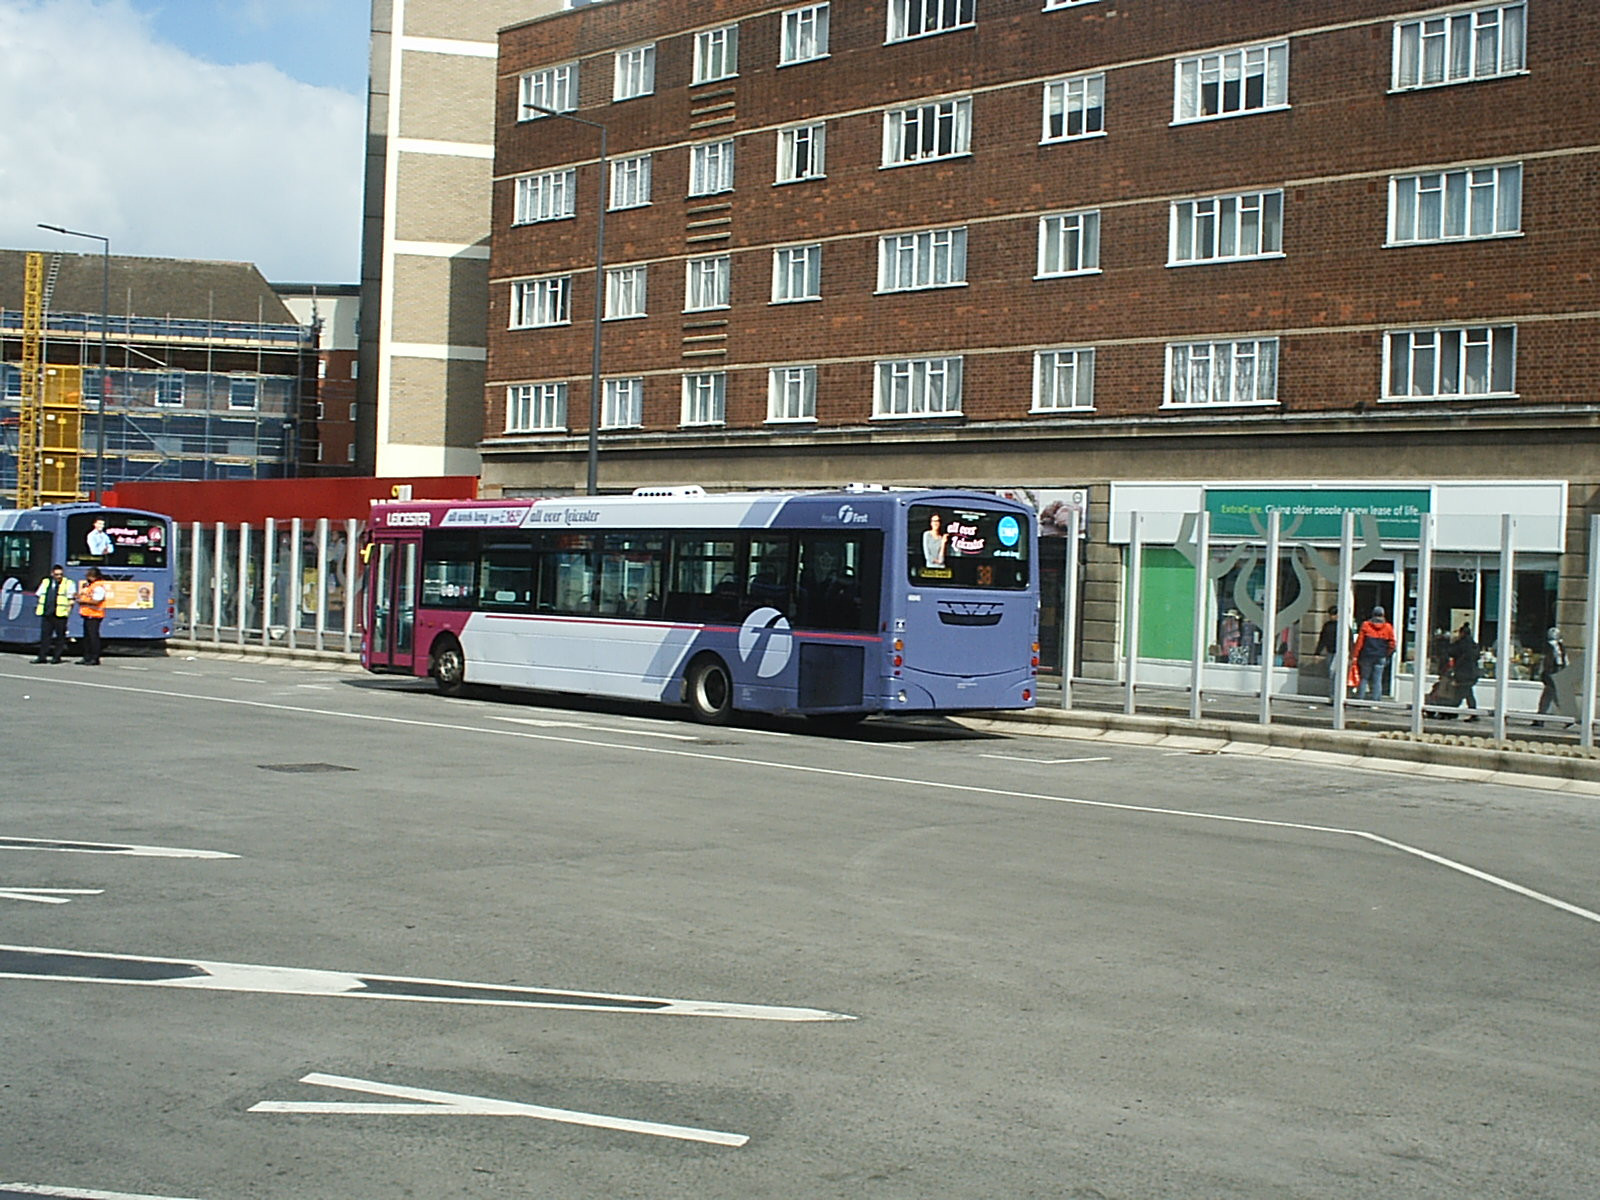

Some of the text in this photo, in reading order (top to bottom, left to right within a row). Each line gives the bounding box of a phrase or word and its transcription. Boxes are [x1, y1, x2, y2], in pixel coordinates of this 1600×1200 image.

[530, 508, 601, 526] all over Leicester
[1265, 505, 1291, 515] Giving
[1292, 505, 1313, 515] older
[1314, 506, 1342, 516] people
[1351, 507, 1369, 515] new
[1370, 505, 1392, 516] lease
[1393, 505, 1405, 516] of
[386, 512, 431, 527] LEICESTER
